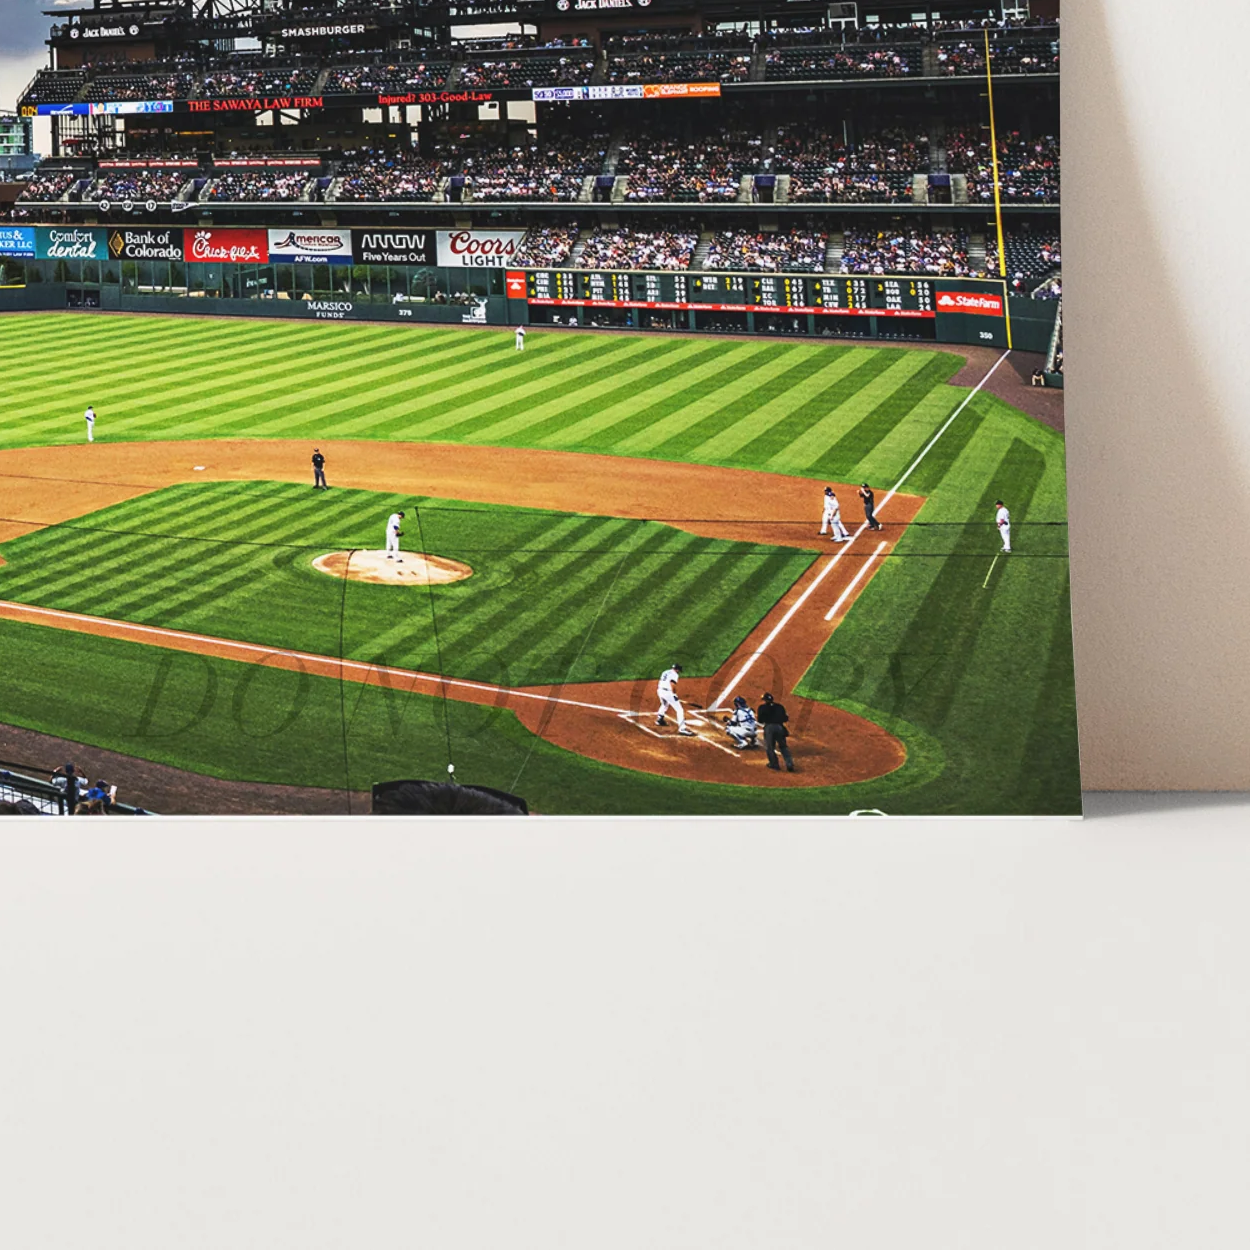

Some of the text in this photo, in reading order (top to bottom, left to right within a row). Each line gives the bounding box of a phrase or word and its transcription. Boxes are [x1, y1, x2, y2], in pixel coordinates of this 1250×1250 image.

[82, 28, 99, 38] JACK
[281, 25, 365, 38] SMASHBURGER
[188, 96, 324, 112] THE SAWAYA LAW FIRM
[378, 91, 493, 106] Injured? 303-Good-Law
[12, 229, 24, 241] &
[125, 230, 171, 244] Bank of
[17, 240, 33, 249] LLC
[361, 234, 426, 249] ARROW
[448, 231, 515, 255] Coors
[46, 240, 97, 258] dental
[125, 244, 182, 258] Colorado
[294, 255, 328, 263] AFW.com
[362, 251, 426, 263] Five Years Out
[462, 255, 504, 267] LIGHT
[753, 280, 760, 288] 7
[755, 295, 762, 303] 7
[307, 301, 353, 312] MARSICO
[979, 332, 993, 340] 350
